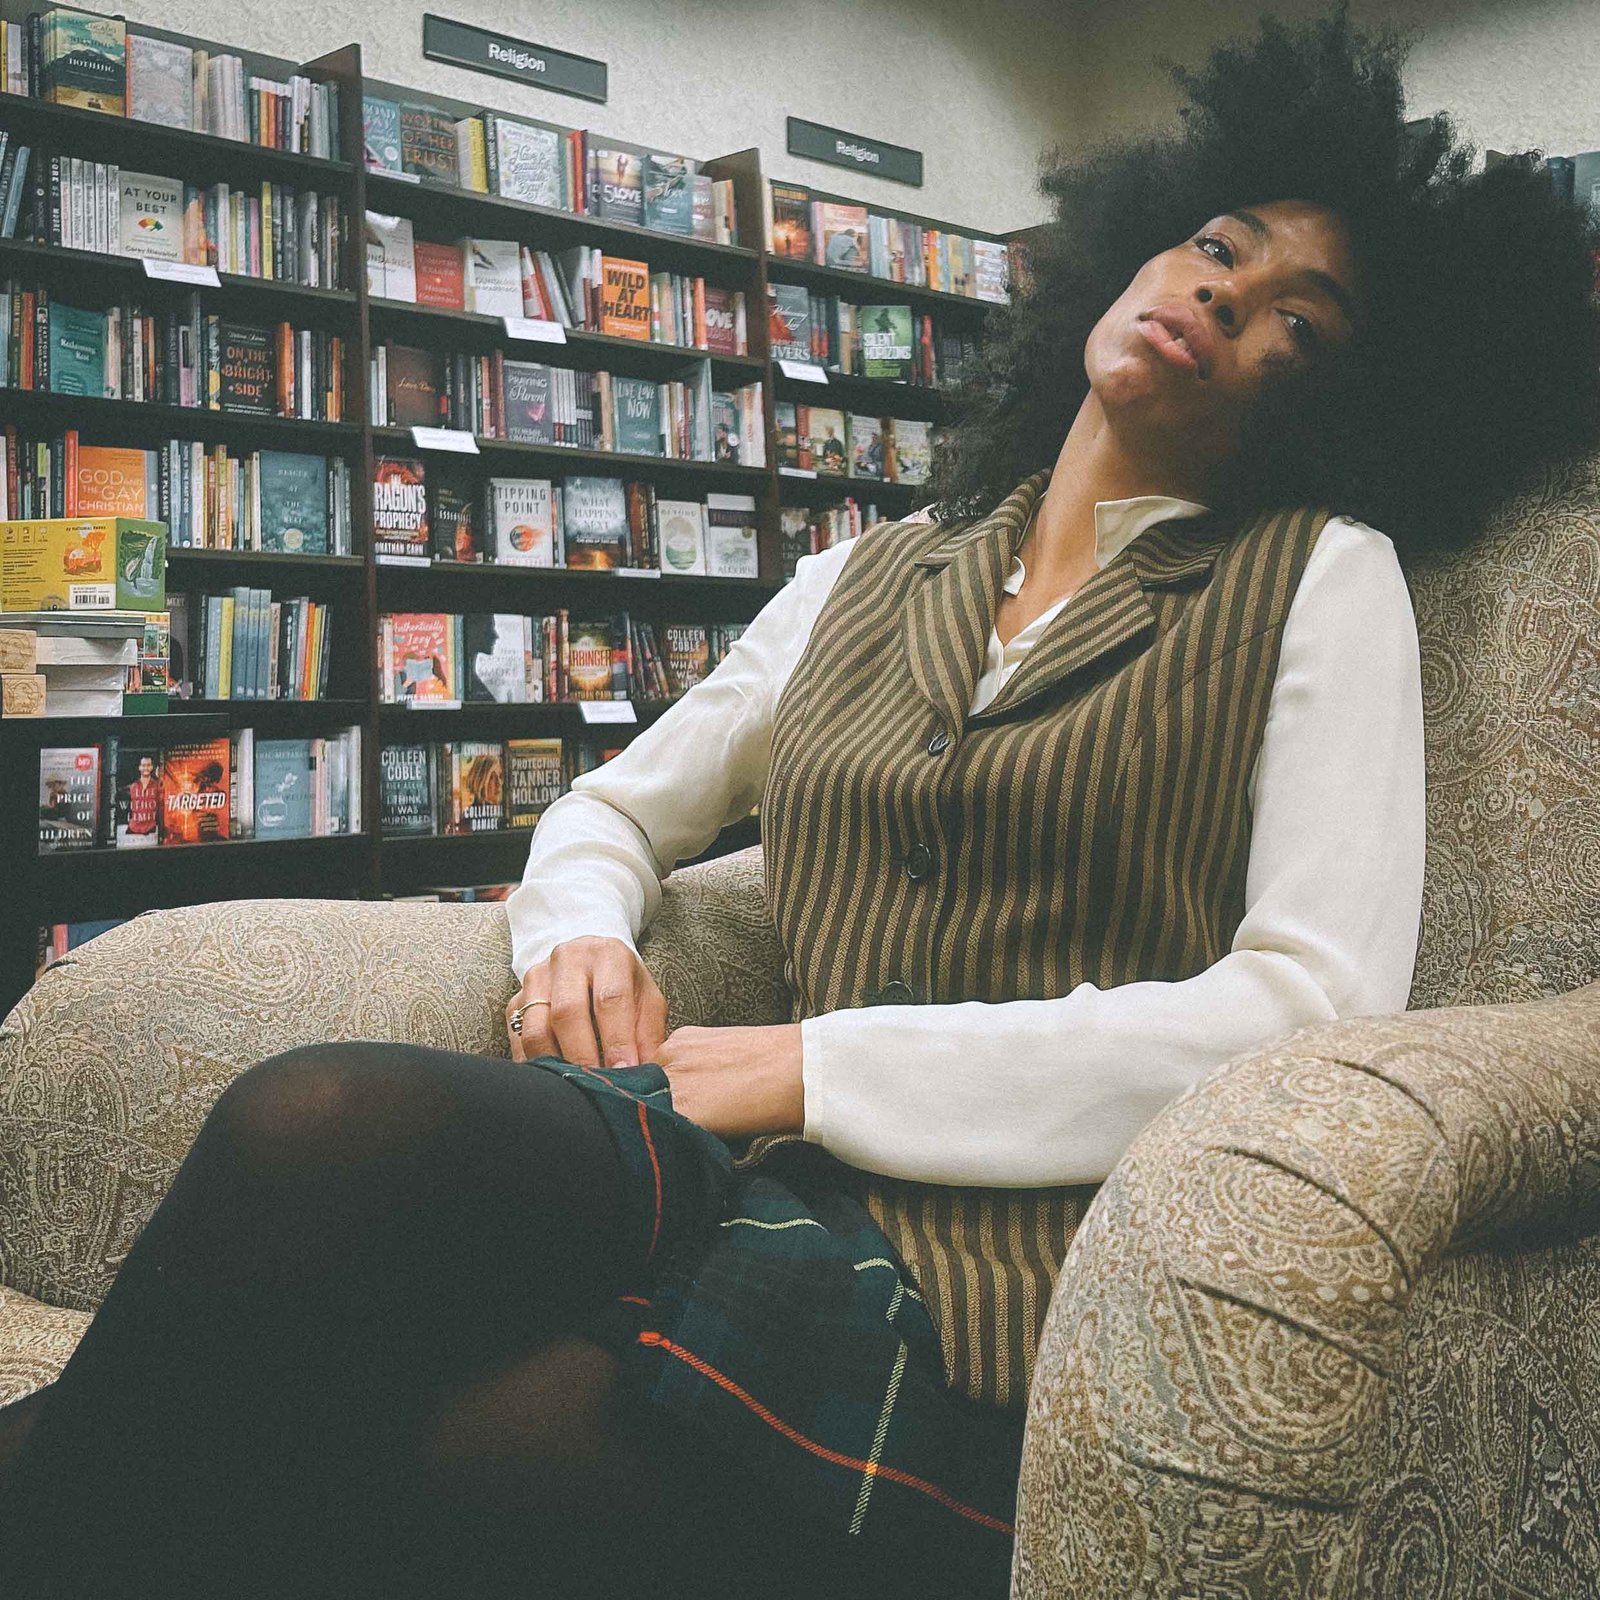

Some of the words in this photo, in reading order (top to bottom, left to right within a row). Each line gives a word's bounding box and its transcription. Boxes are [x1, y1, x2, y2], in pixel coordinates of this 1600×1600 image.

[488, 42, 546, 72] Religion
[401, 145, 459, 173] TRUST
[835, 140, 880, 164] Religion
[124, 187, 140, 198] AT
[145, 189, 178, 204] YOUR
[135, 201, 168, 215] BEST
[607, 269, 645, 290] WILD
[617, 287, 638, 304] AT
[602, 300, 653, 322] HEART
[705, 305, 734, 330] OVE
[226, 346, 244, 360] ON
[248, 350, 268, 364] THE
[769, 345, 811, 361] IVERS
[224, 363, 271, 382] BRIGHT
[234, 382, 263, 398] SIDE
[618, 381, 636, 399] LIVE
[638, 383, 656, 401] LOVE
[626, 399, 654, 420] NOW
[78, 468, 125, 487] GOD
[101, 485, 145, 502] GAY
[373, 481, 427, 514] RAGON'S
[497, 486, 547, 501] TIPPING
[78, 499, 145, 513] CHRISTIAN
[504, 502, 540, 515] POINT
[580, 497, 610, 508] WHAT
[373, 511, 423, 530] PROPHECY
[573, 508, 619, 519] HAPPENS
[584, 519, 609, 530] NEXT
[374, 541, 405, 555] ONATHAN
[667, 629, 706, 641] COLLEEN
[672, 640, 700, 652] COBLE
[670, 660, 700, 671] WHAT
[381, 750, 426, 767] COLLEEN
[511, 757, 561, 770] PROTECTING
[387, 765, 422, 781] COBLE
[511, 769, 561, 787] TANNER
[56, 792, 92, 804] PRICE
[167, 791, 227, 811] TARGETED
[392, 794, 423, 805] THINK
[512, 786, 561, 805] HOLLOW
[119, 800, 157, 811] WITHO
[397, 805, 419, 815] WAS
[127, 811, 157, 822] LIMIT
[381, 814, 432, 825] MURDERED
